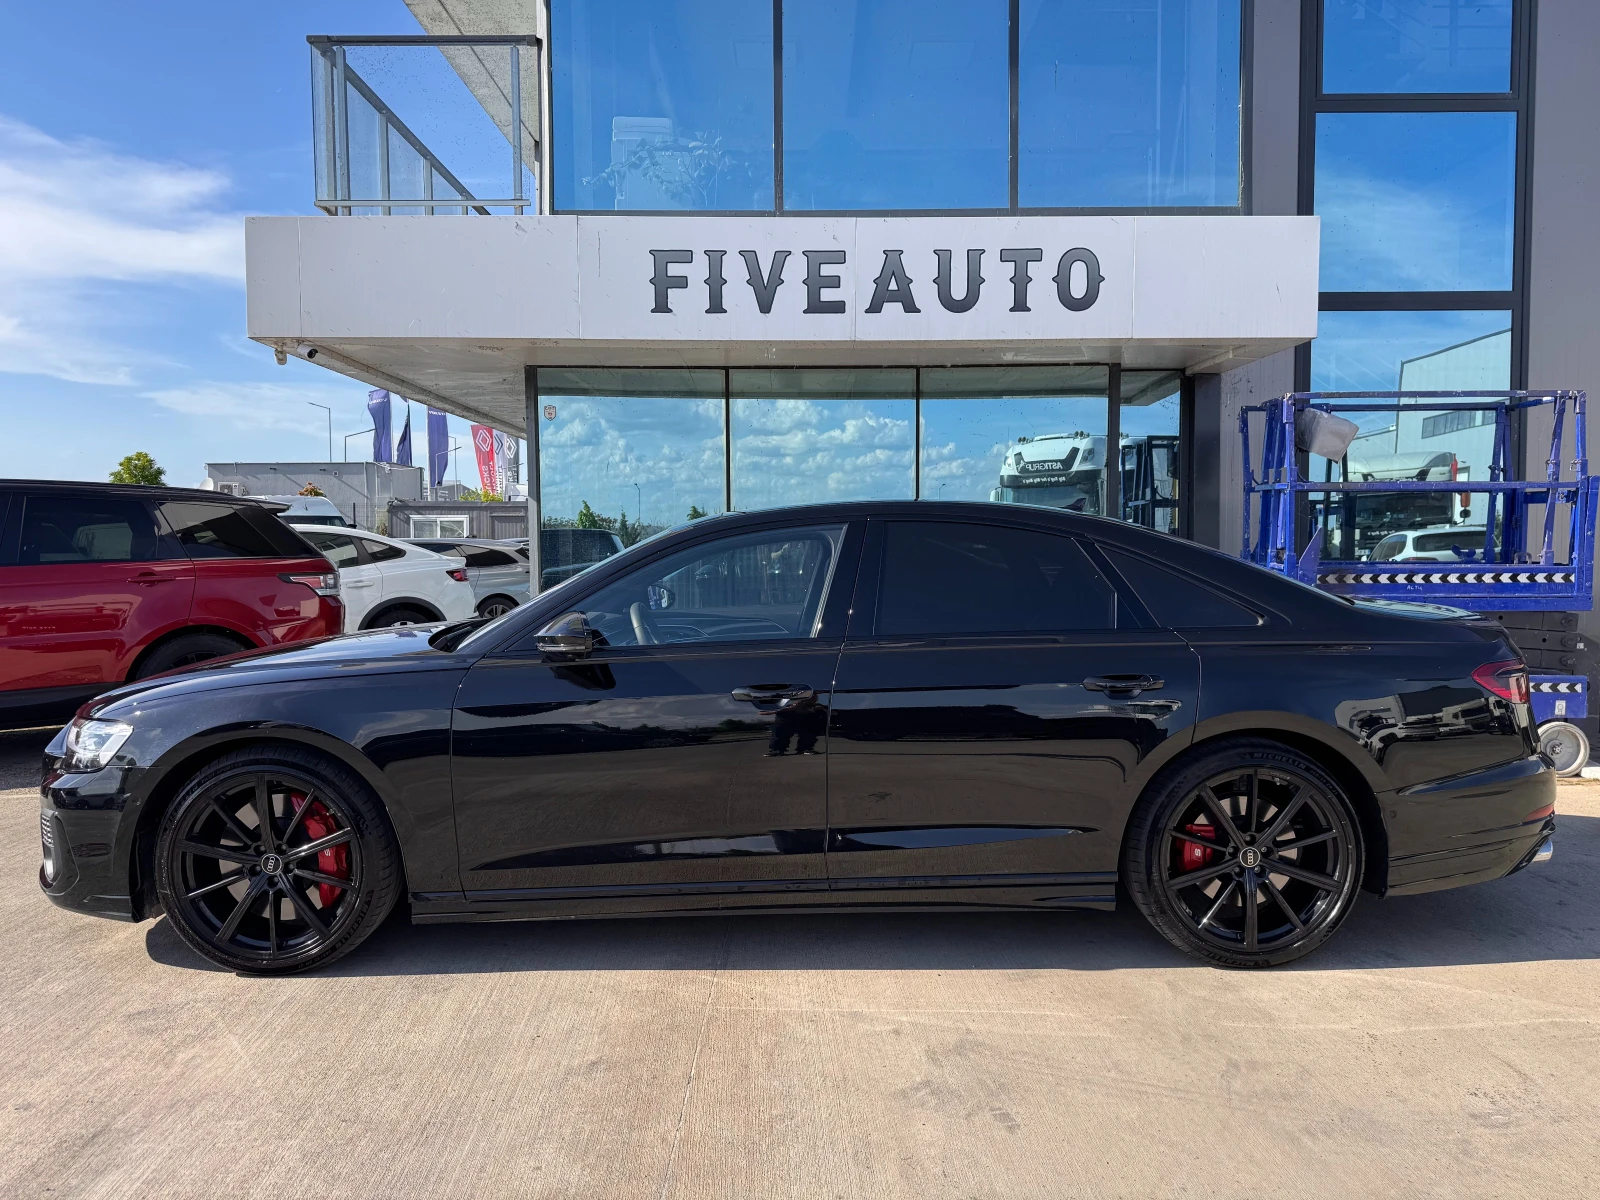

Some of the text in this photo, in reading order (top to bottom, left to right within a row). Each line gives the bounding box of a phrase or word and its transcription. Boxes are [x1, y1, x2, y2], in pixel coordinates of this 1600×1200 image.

[649, 247, 1106, 315] FIVE AUTO
[1252, 751, 1307, 770] MICHELIN
[334, 902, 371, 950] MICHELIN
